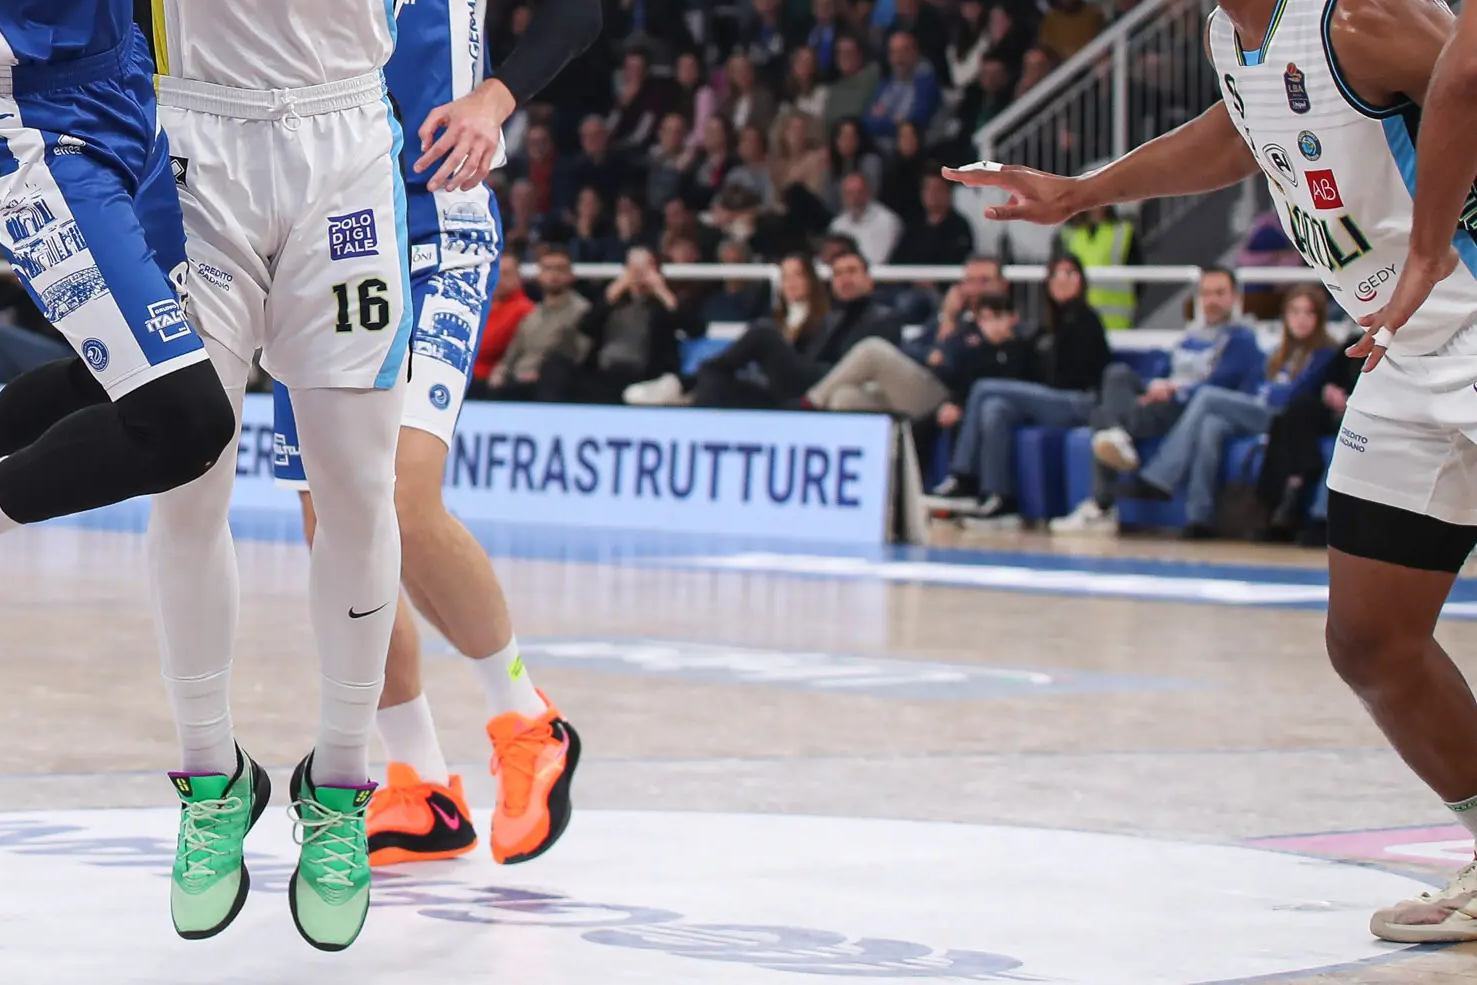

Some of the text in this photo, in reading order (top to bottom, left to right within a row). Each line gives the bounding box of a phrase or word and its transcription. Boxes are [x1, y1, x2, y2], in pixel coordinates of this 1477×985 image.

[1312, 178, 1337, 202] AB
[332, 214, 371, 233] POLO
[333, 227, 371, 245] DIGI
[334, 239, 374, 255] TALE
[198, 263, 233, 282] CREDITO
[1358, 264, 1398, 294] GEDY
[331, 278, 390, 333] 16
